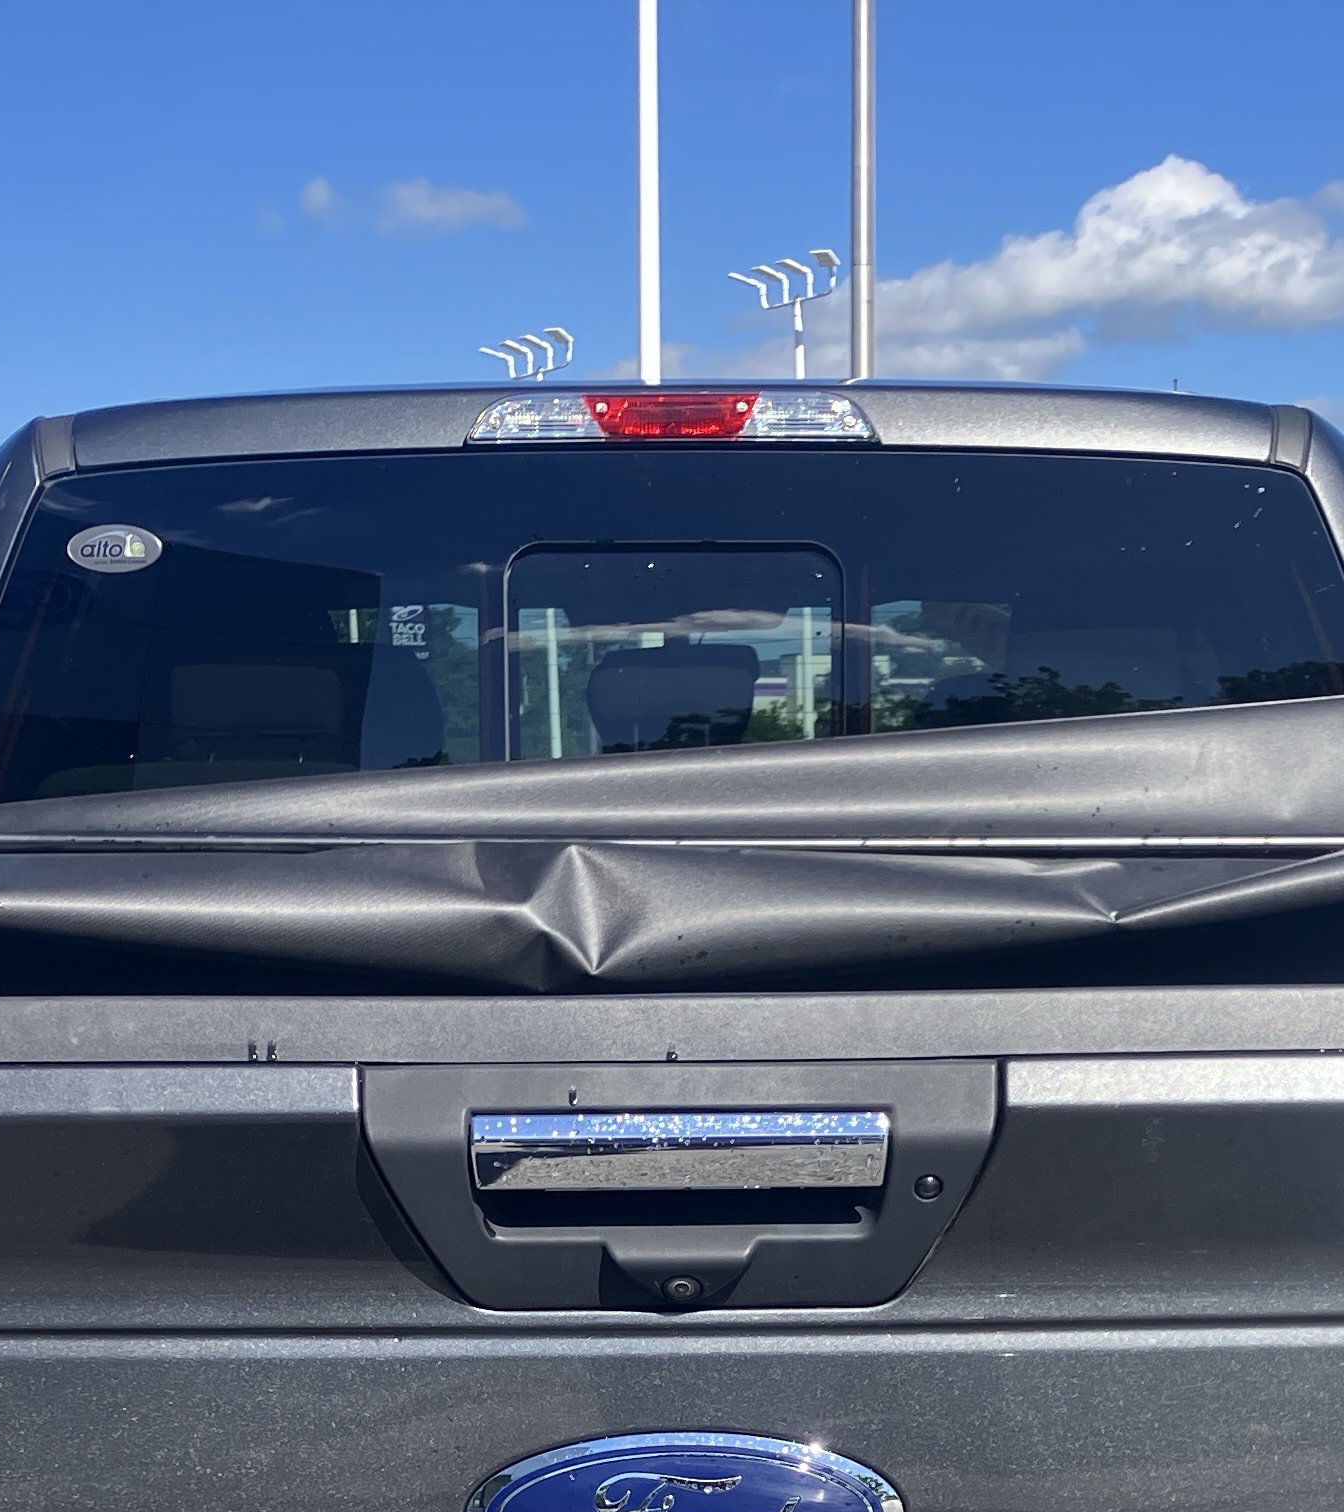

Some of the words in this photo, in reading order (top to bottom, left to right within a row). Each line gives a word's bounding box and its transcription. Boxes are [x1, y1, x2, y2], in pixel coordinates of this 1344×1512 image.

[80, 540, 123, 557] alto
[388, 622, 426, 634] TACO
[392, 634, 426, 646] BELL
